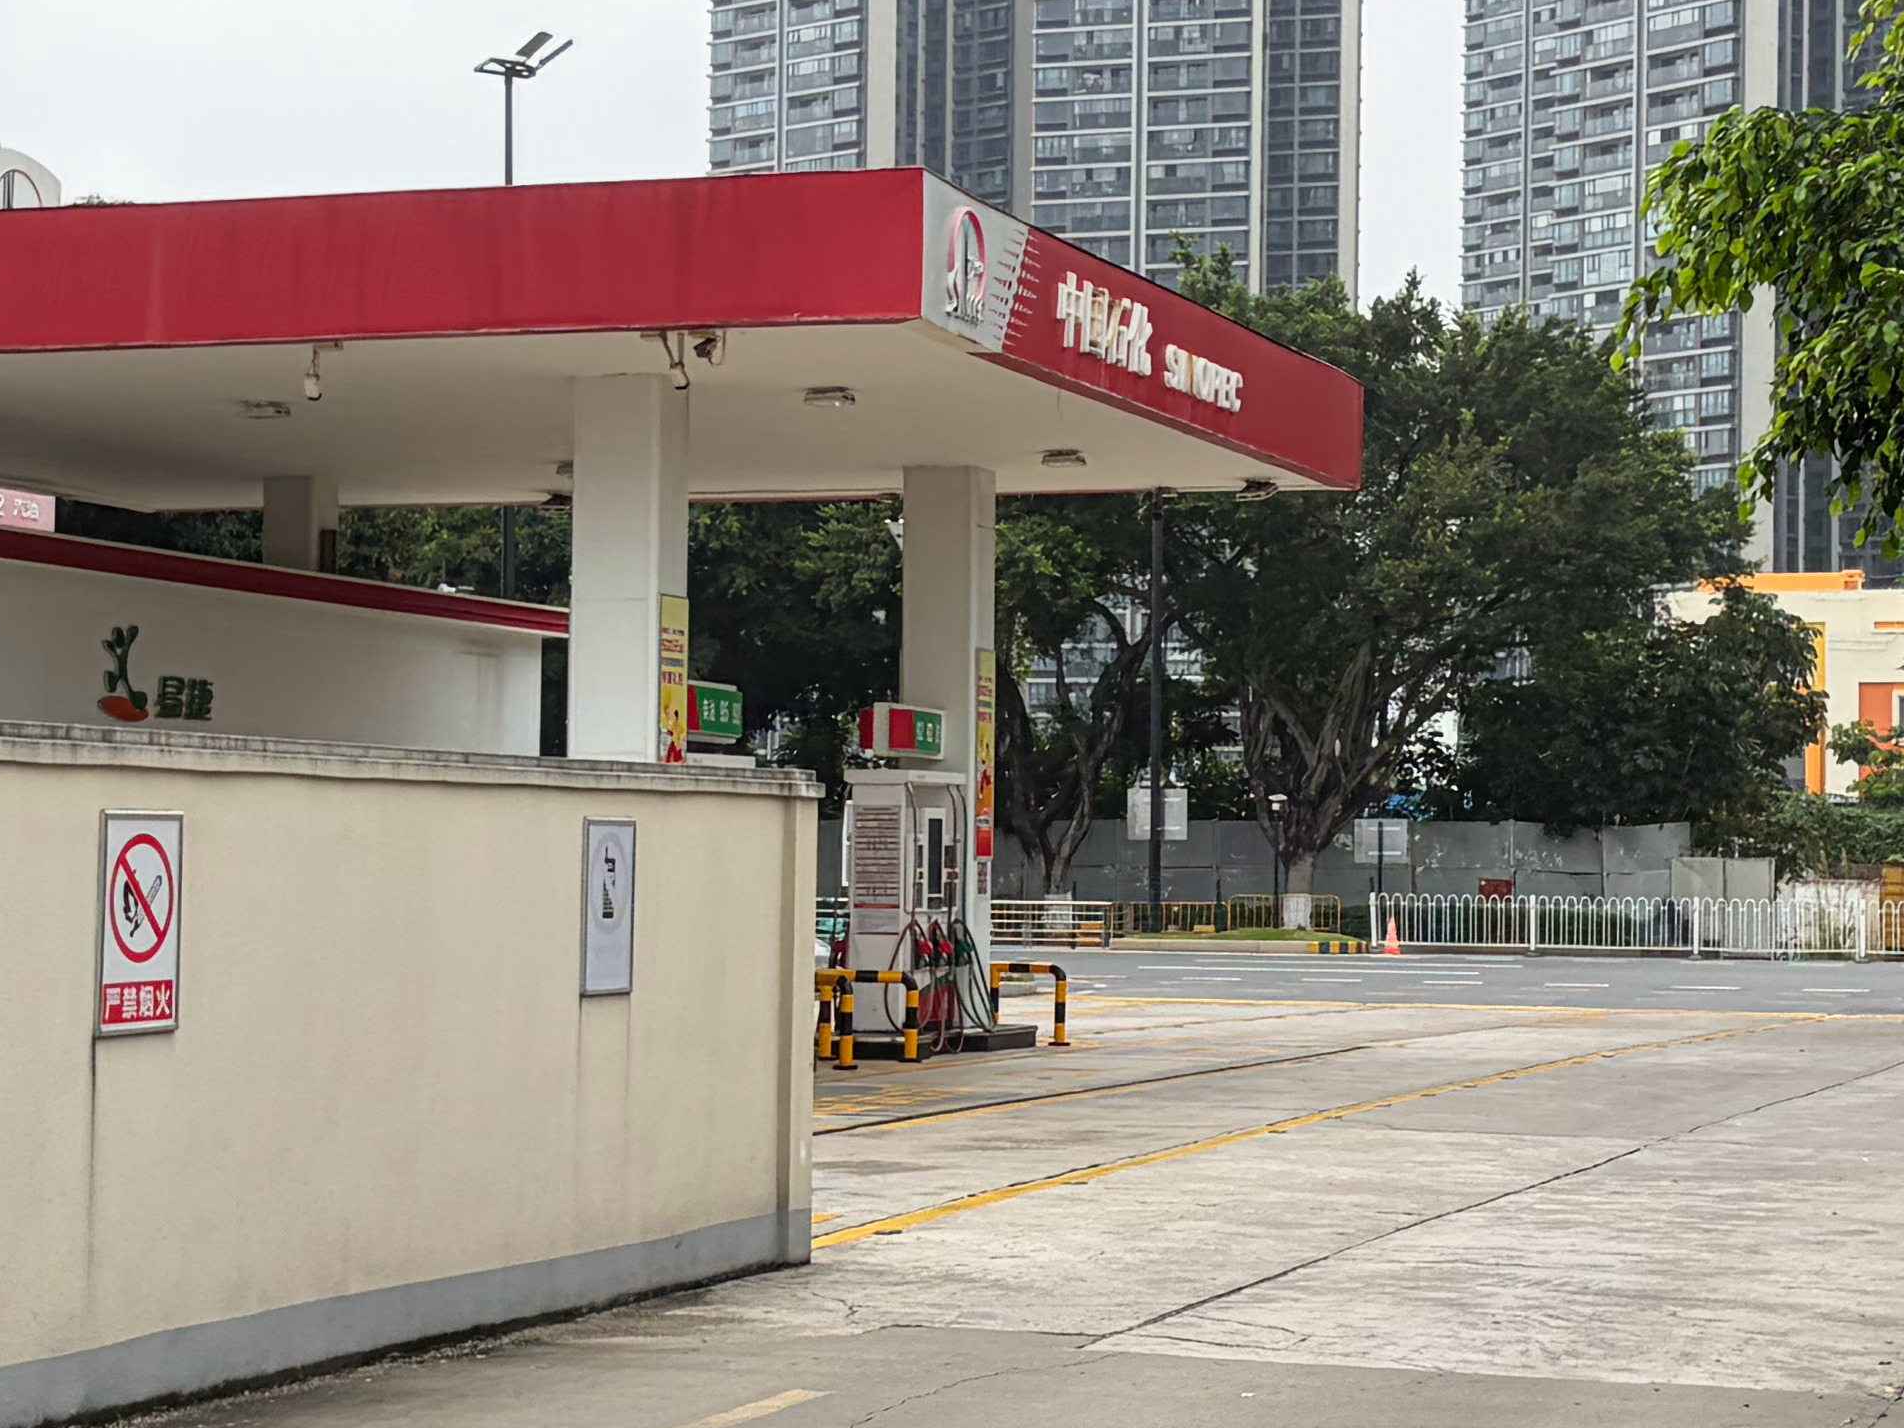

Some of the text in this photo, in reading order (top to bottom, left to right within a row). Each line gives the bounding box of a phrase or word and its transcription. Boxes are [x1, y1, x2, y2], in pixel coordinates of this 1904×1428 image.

[1056, 271, 1153, 377] 中国石化
[1164, 343, 1244, 413] SINOPEC
[104, 982, 171, 1021] 严禁烟火
